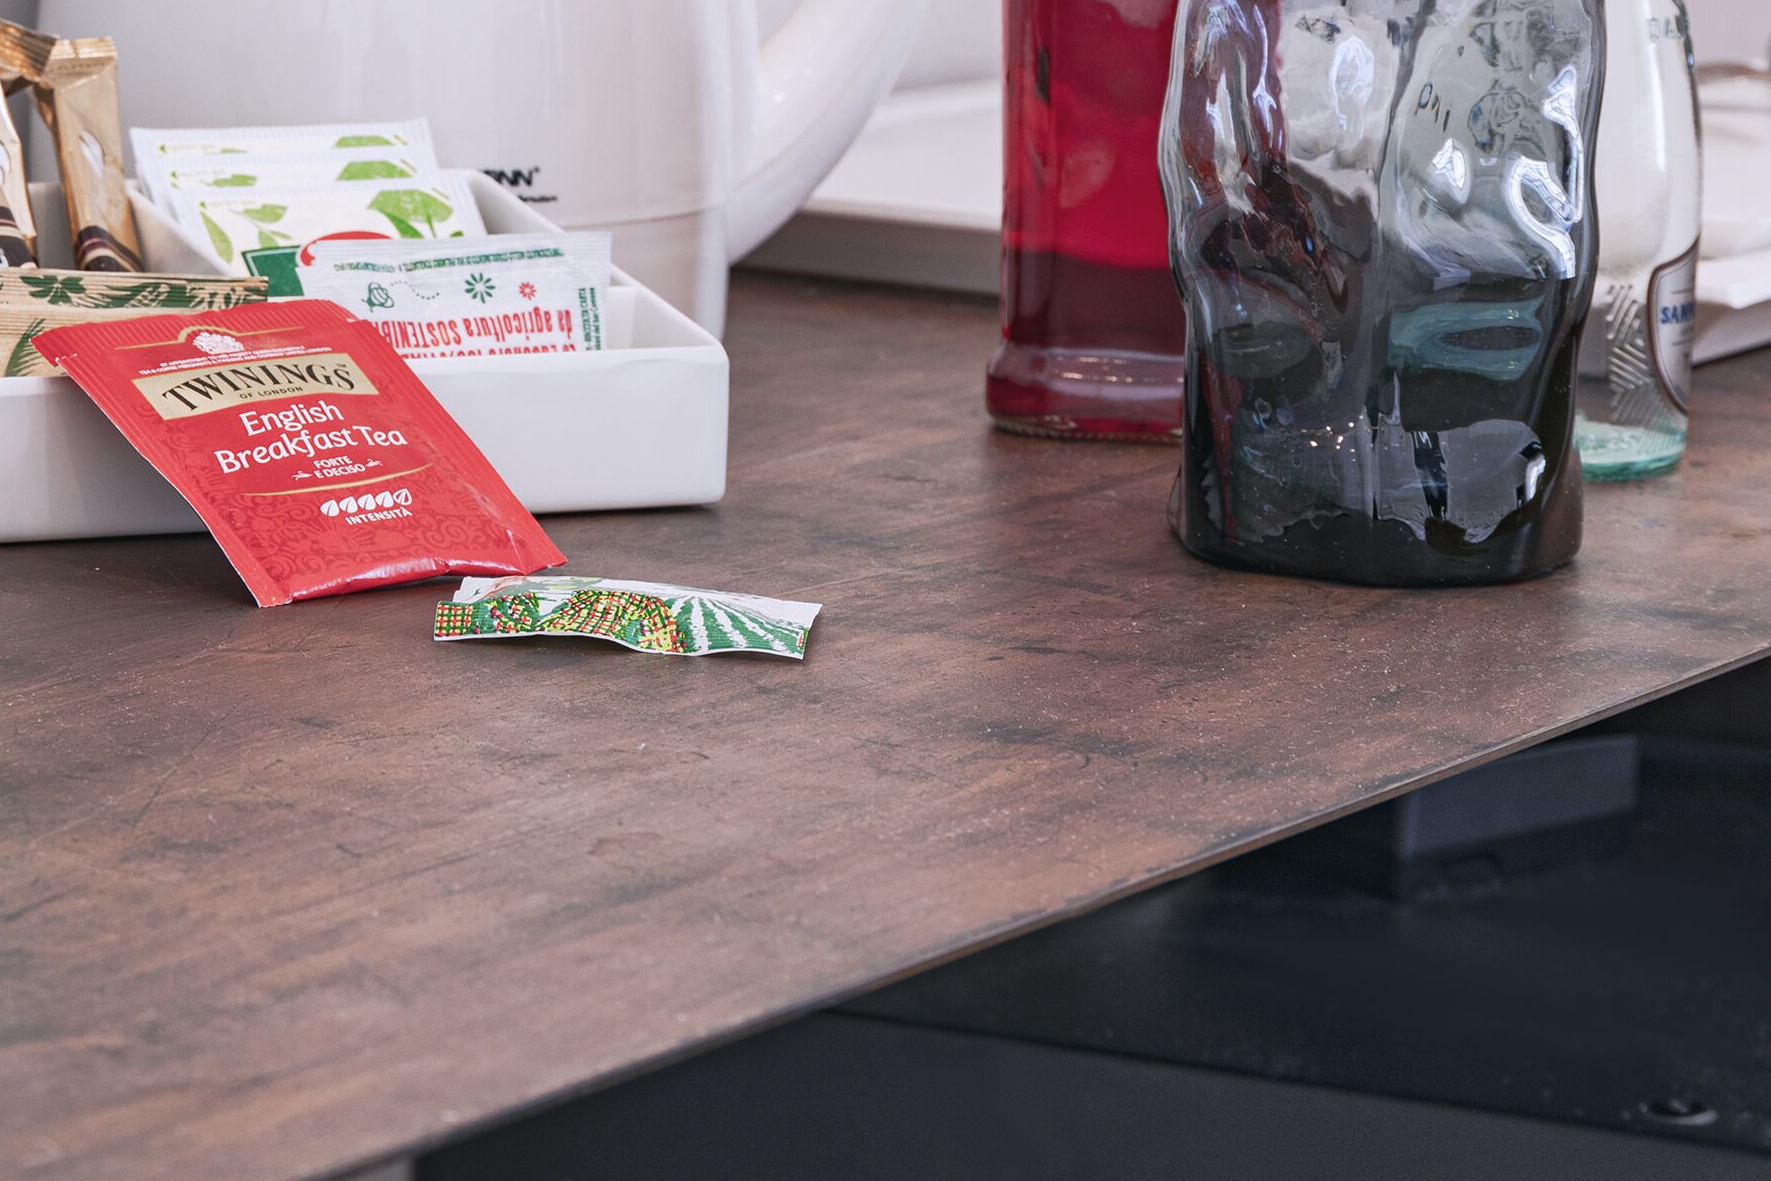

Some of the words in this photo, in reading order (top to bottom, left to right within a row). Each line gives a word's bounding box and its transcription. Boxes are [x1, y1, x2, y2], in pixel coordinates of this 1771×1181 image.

[375, 320, 461, 348] SOSTENIB
[463, 307, 553, 342] agricoltura
[557, 309, 573, 339] da
[239, 392, 253, 400] OF
[259, 386, 304, 397] LONDON
[239, 400, 344, 437] English
[214, 427, 358, 474] Breakfast
[352, 425, 408, 447] Tea
[313, 456, 352, 469] FORTE
[314, 470, 324, 479] E
[323, 463, 366, 477] DECISO
[345, 506, 413, 525] INTENSITÀ
